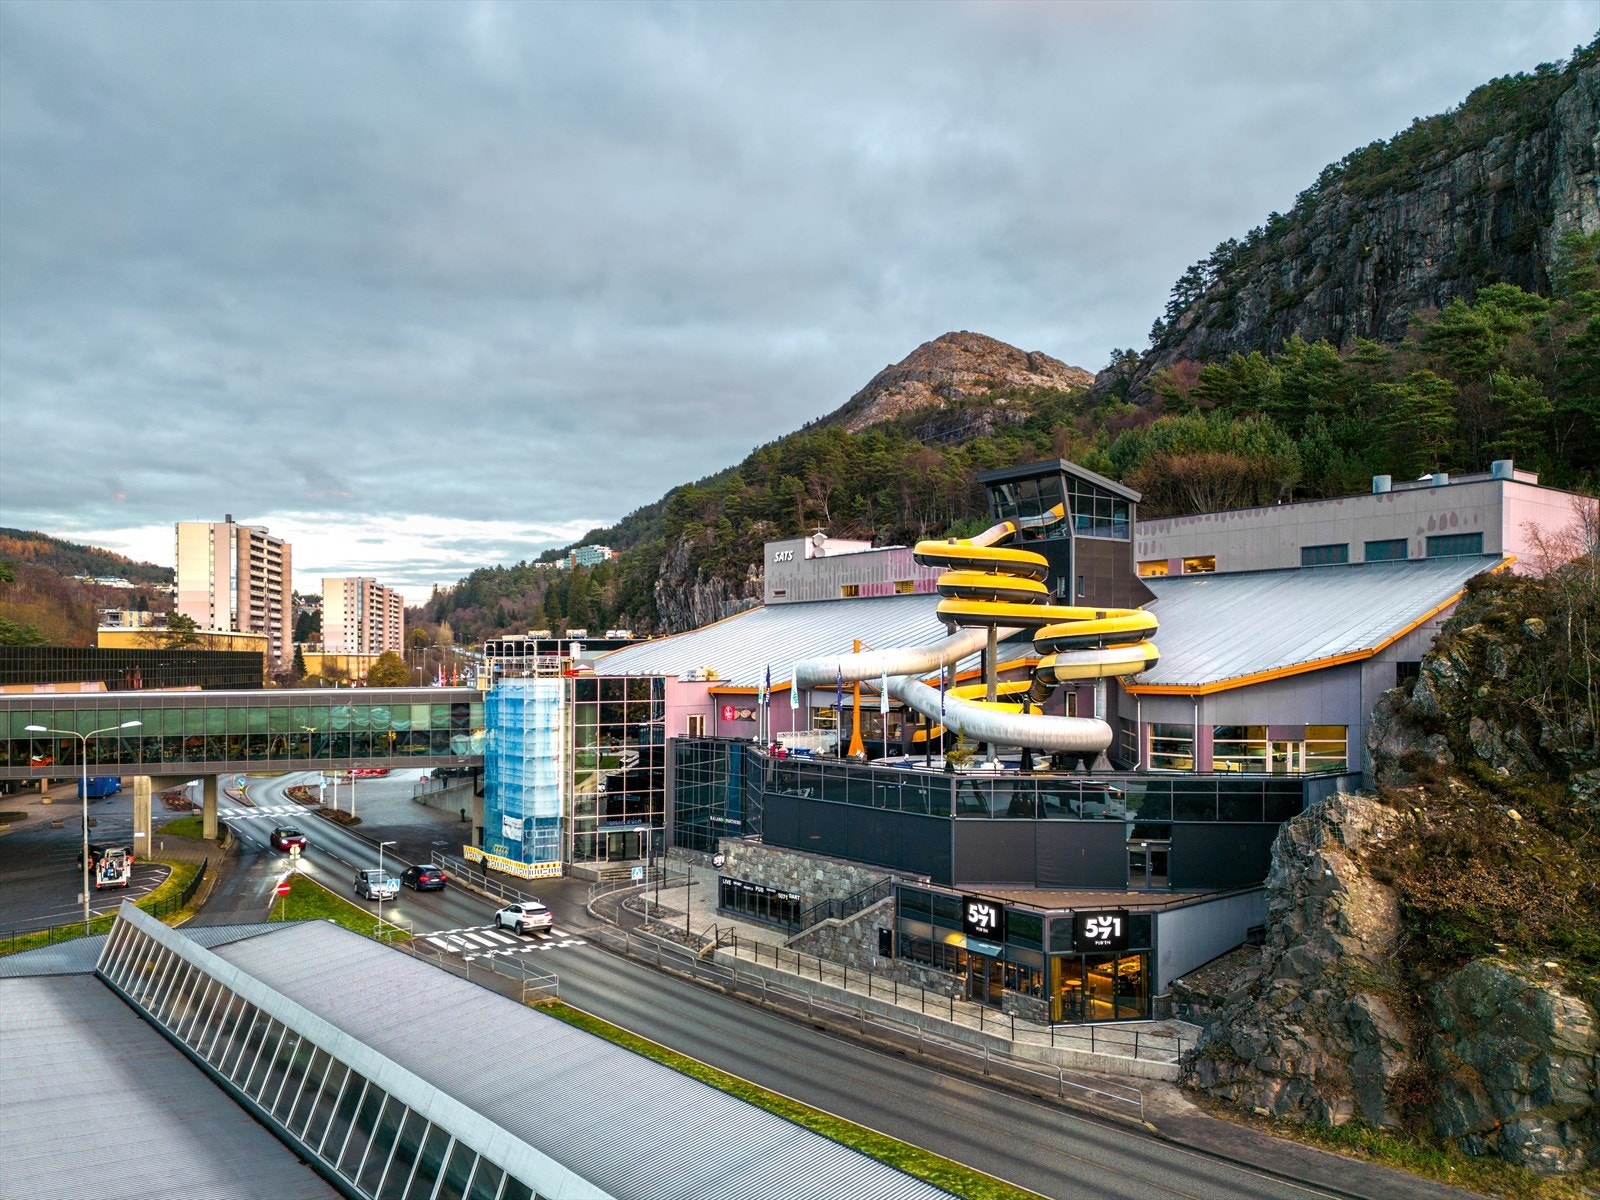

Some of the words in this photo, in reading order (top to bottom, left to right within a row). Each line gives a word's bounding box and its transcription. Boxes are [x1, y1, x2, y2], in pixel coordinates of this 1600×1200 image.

[774, 550, 794, 562] SATS
[722, 878, 732, 886] LIVE
[788, 893, 801, 901] DART
